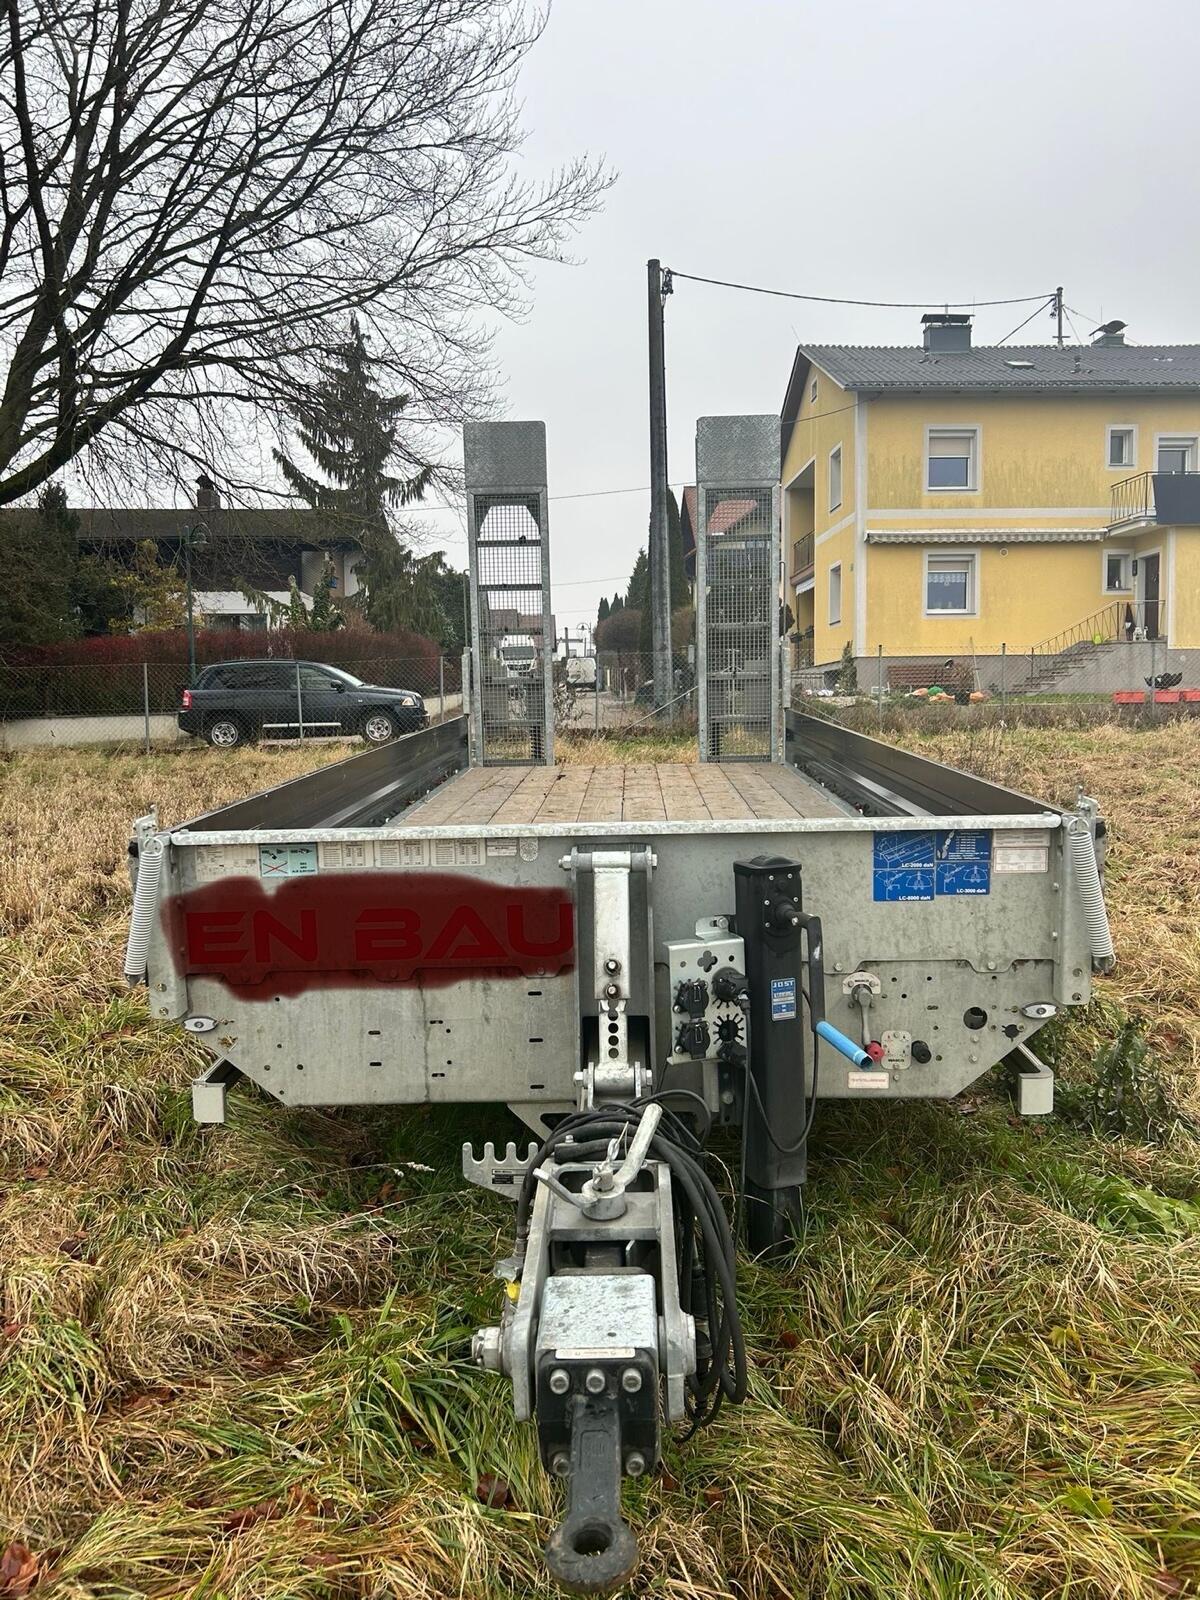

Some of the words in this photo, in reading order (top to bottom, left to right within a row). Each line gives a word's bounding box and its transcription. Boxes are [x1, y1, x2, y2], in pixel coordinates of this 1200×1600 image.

[186, 909, 318, 965] EN
[355, 903, 574, 962] BAU
[773, 980, 794, 988] JOST
